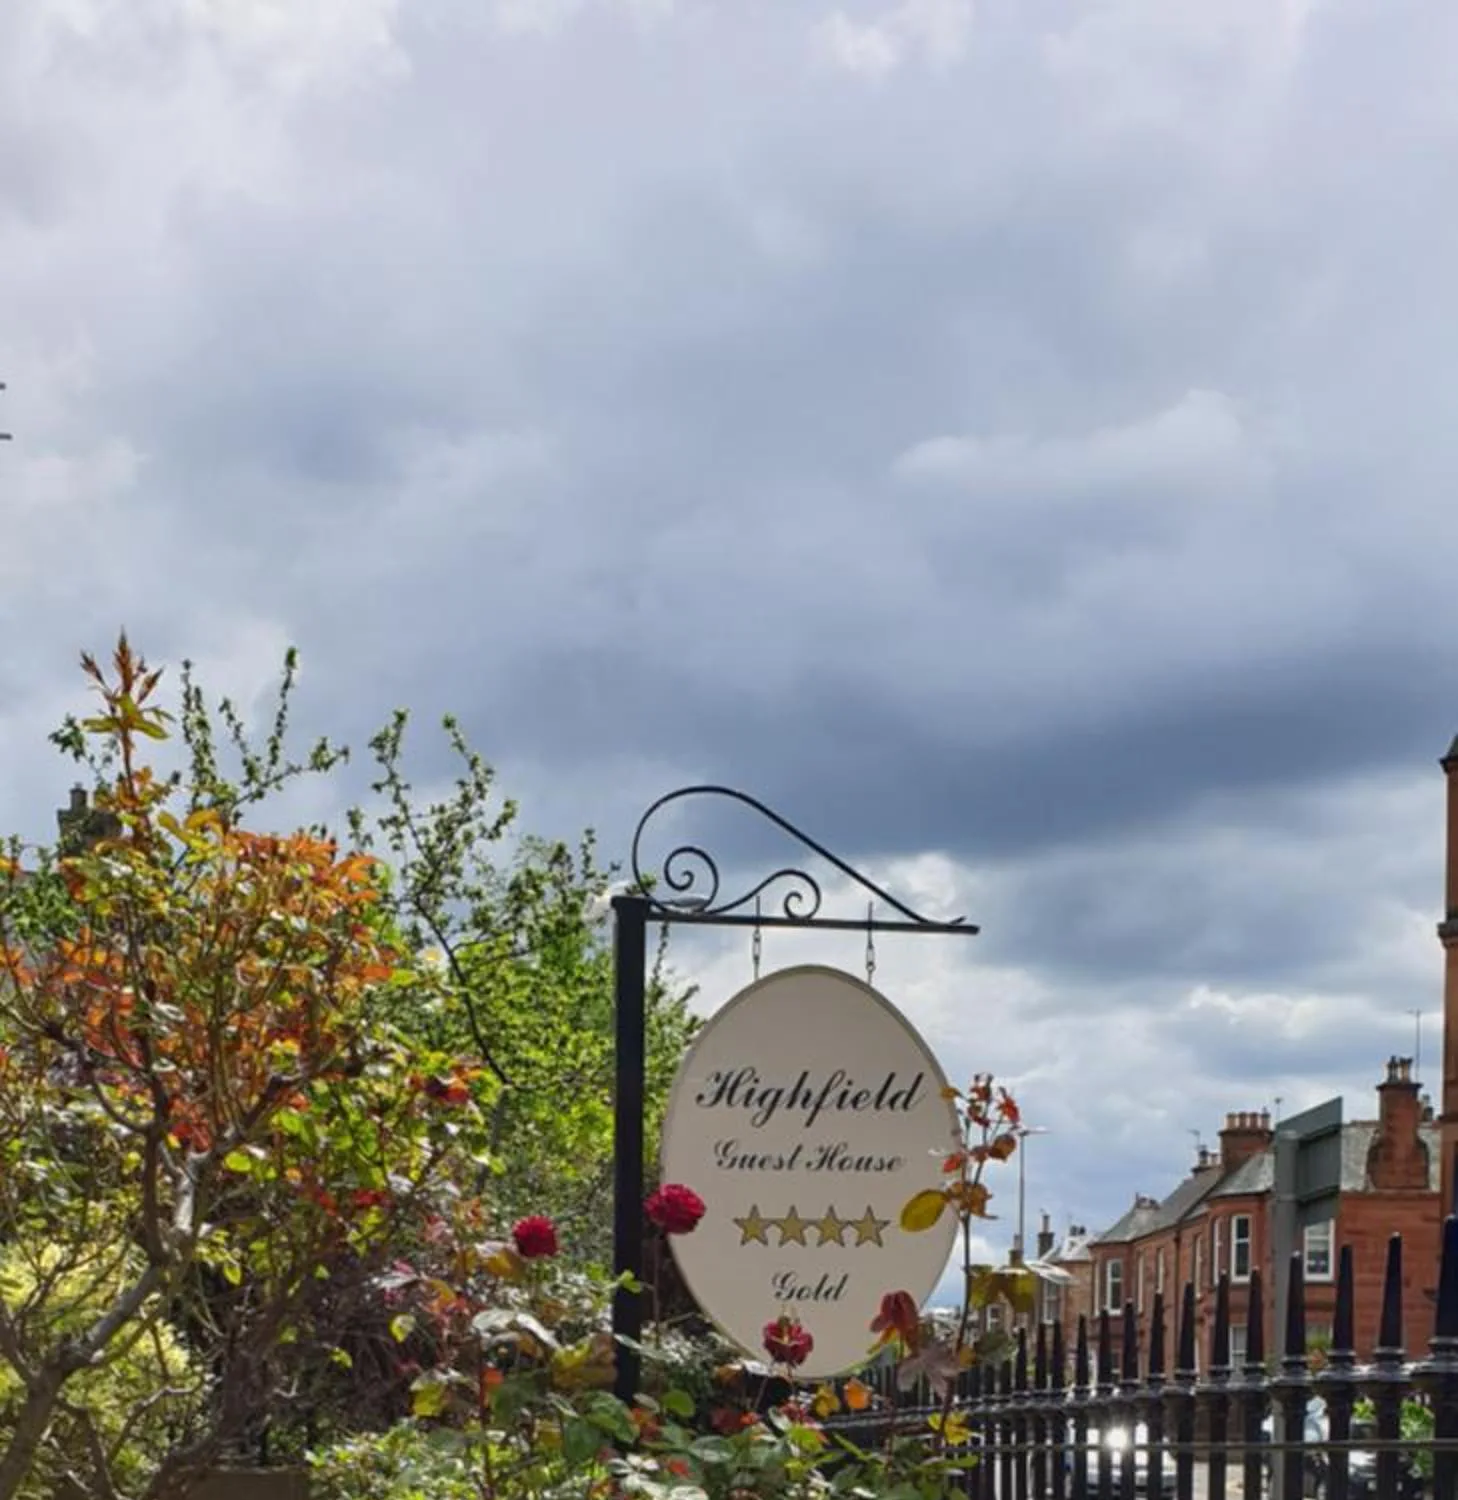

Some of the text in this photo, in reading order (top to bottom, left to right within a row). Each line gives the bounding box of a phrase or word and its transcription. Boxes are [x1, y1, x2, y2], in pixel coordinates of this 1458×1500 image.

[696, 1066, 926, 1128] Highfield
[714, 1139, 903, 1172] Guest House
[771, 1270, 849, 1302] Gold
